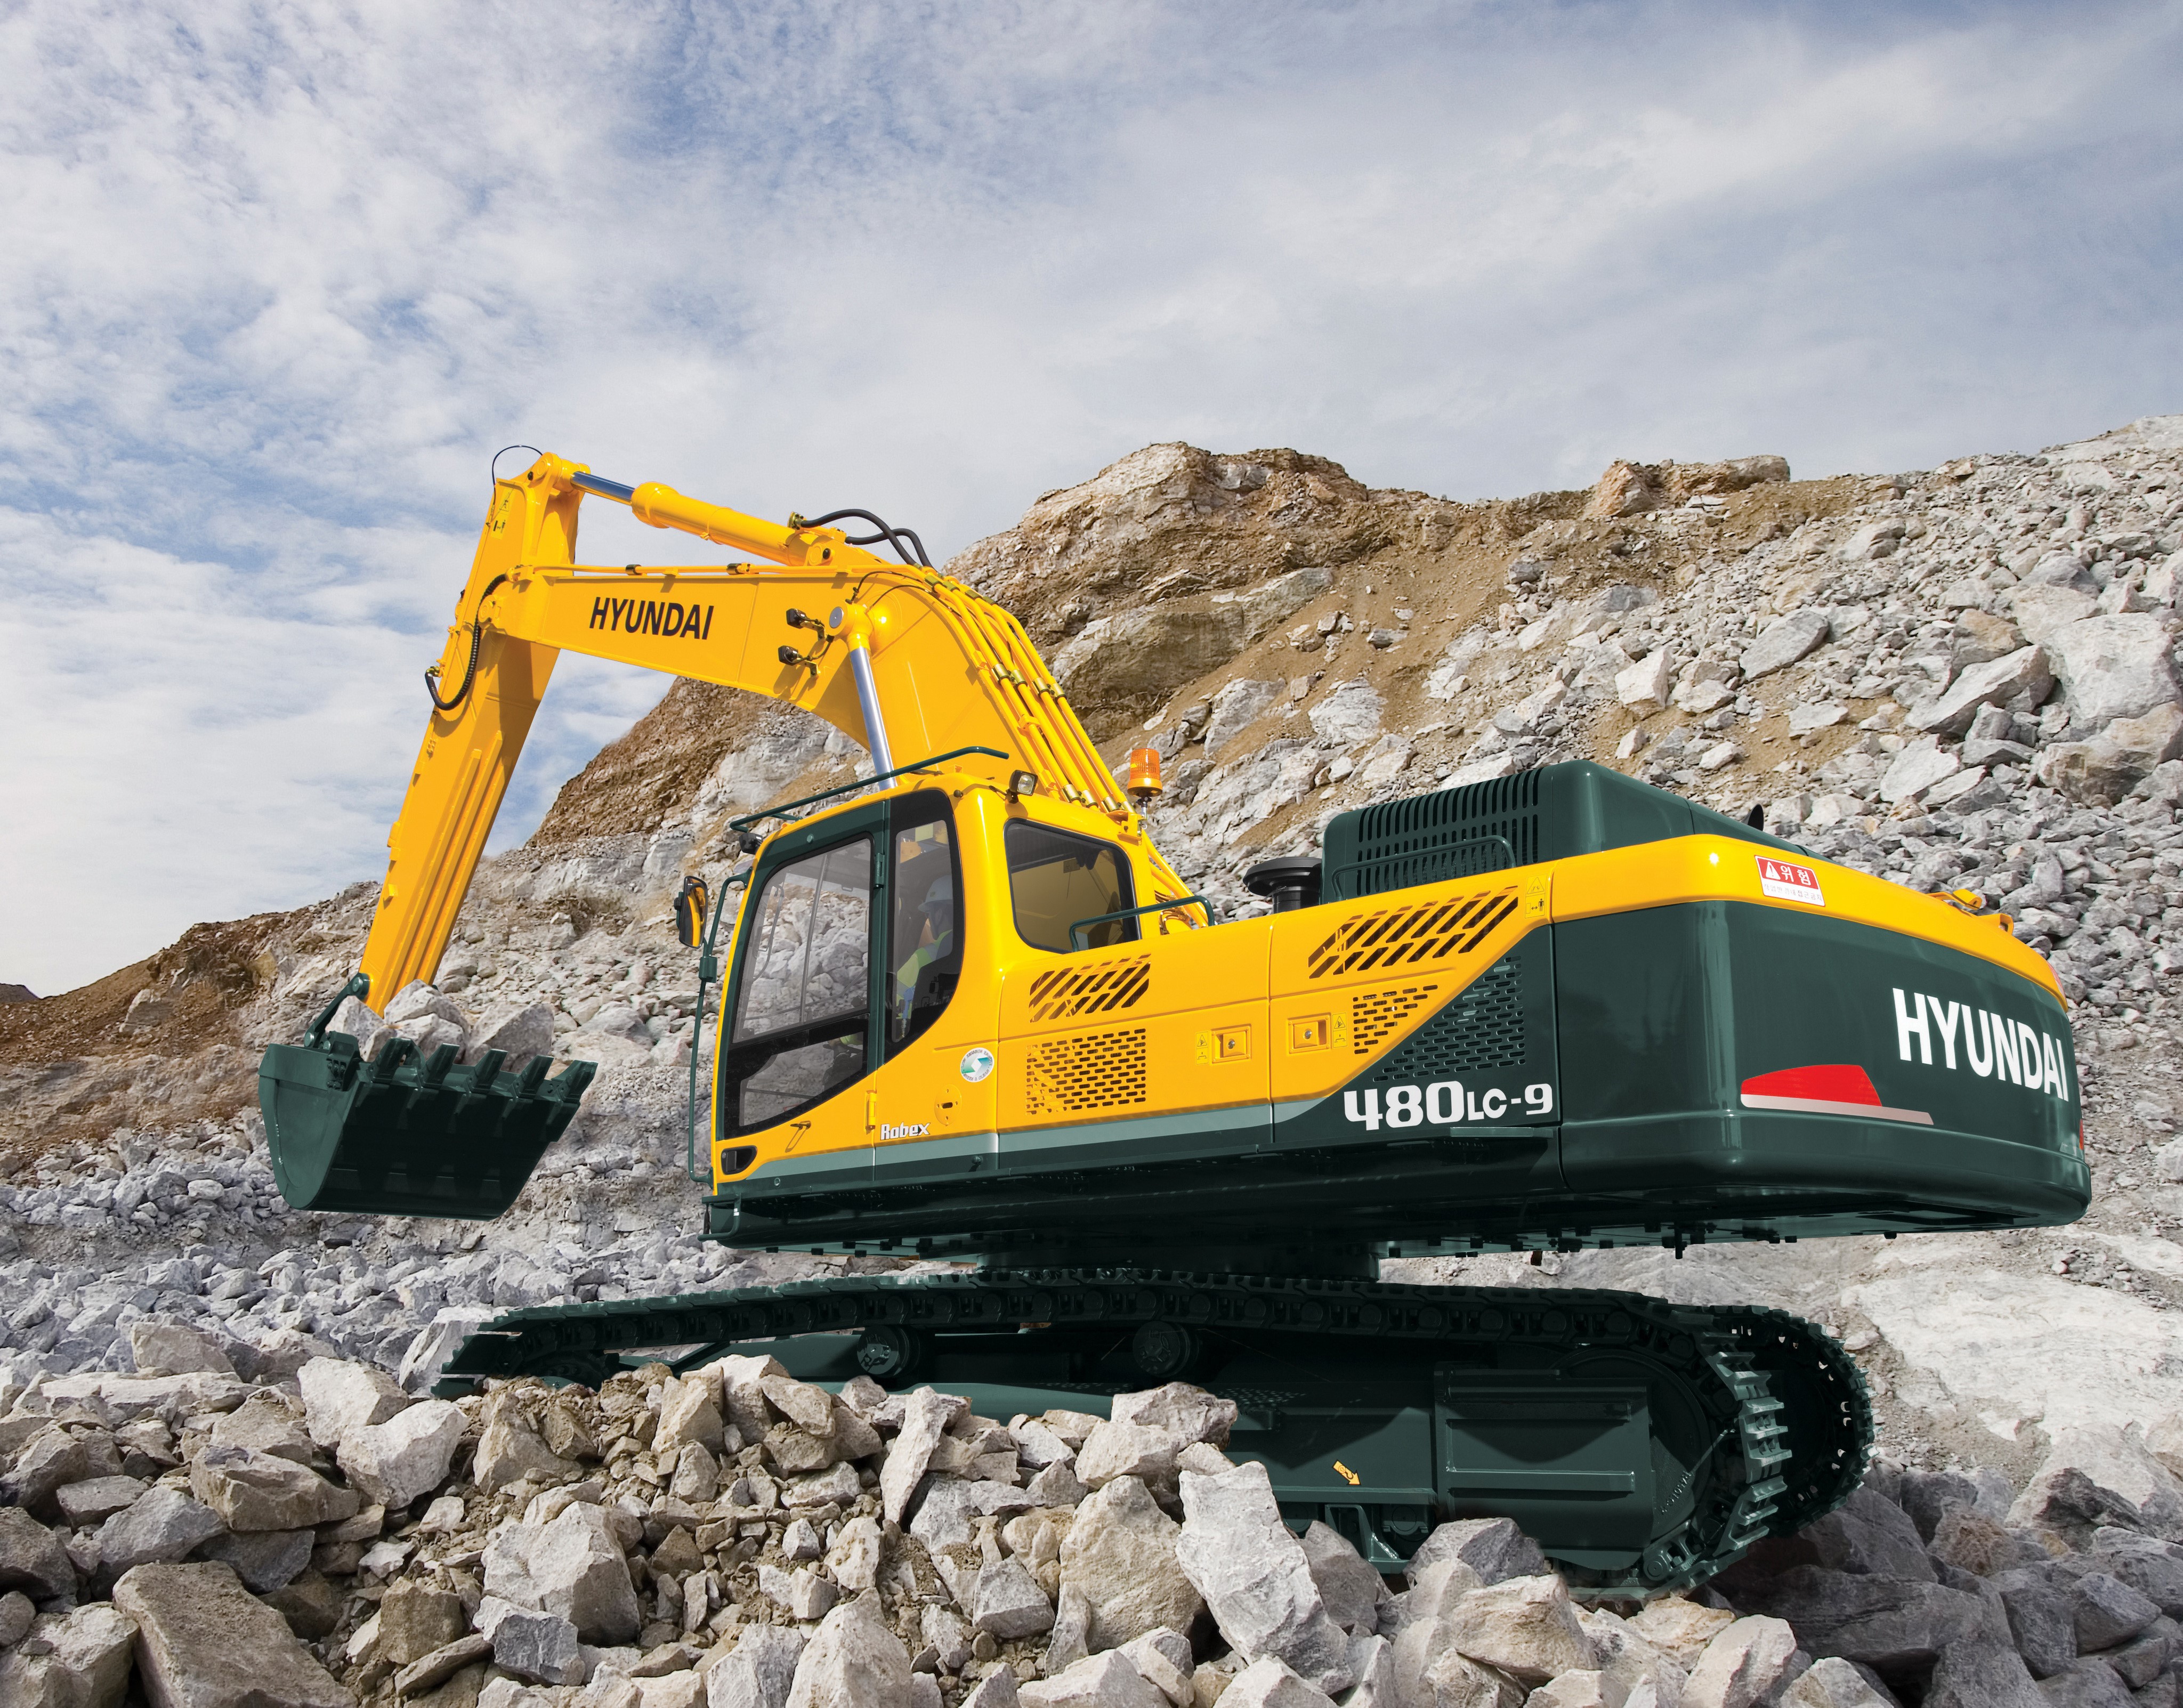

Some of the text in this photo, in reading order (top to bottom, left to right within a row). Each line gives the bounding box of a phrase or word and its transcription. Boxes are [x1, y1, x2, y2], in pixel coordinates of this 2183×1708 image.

[589, 596, 714, 640] HYUNDAI
[1893, 987, 2069, 1102] HYUNDAI
[880, 1121, 931, 1140] Robex
